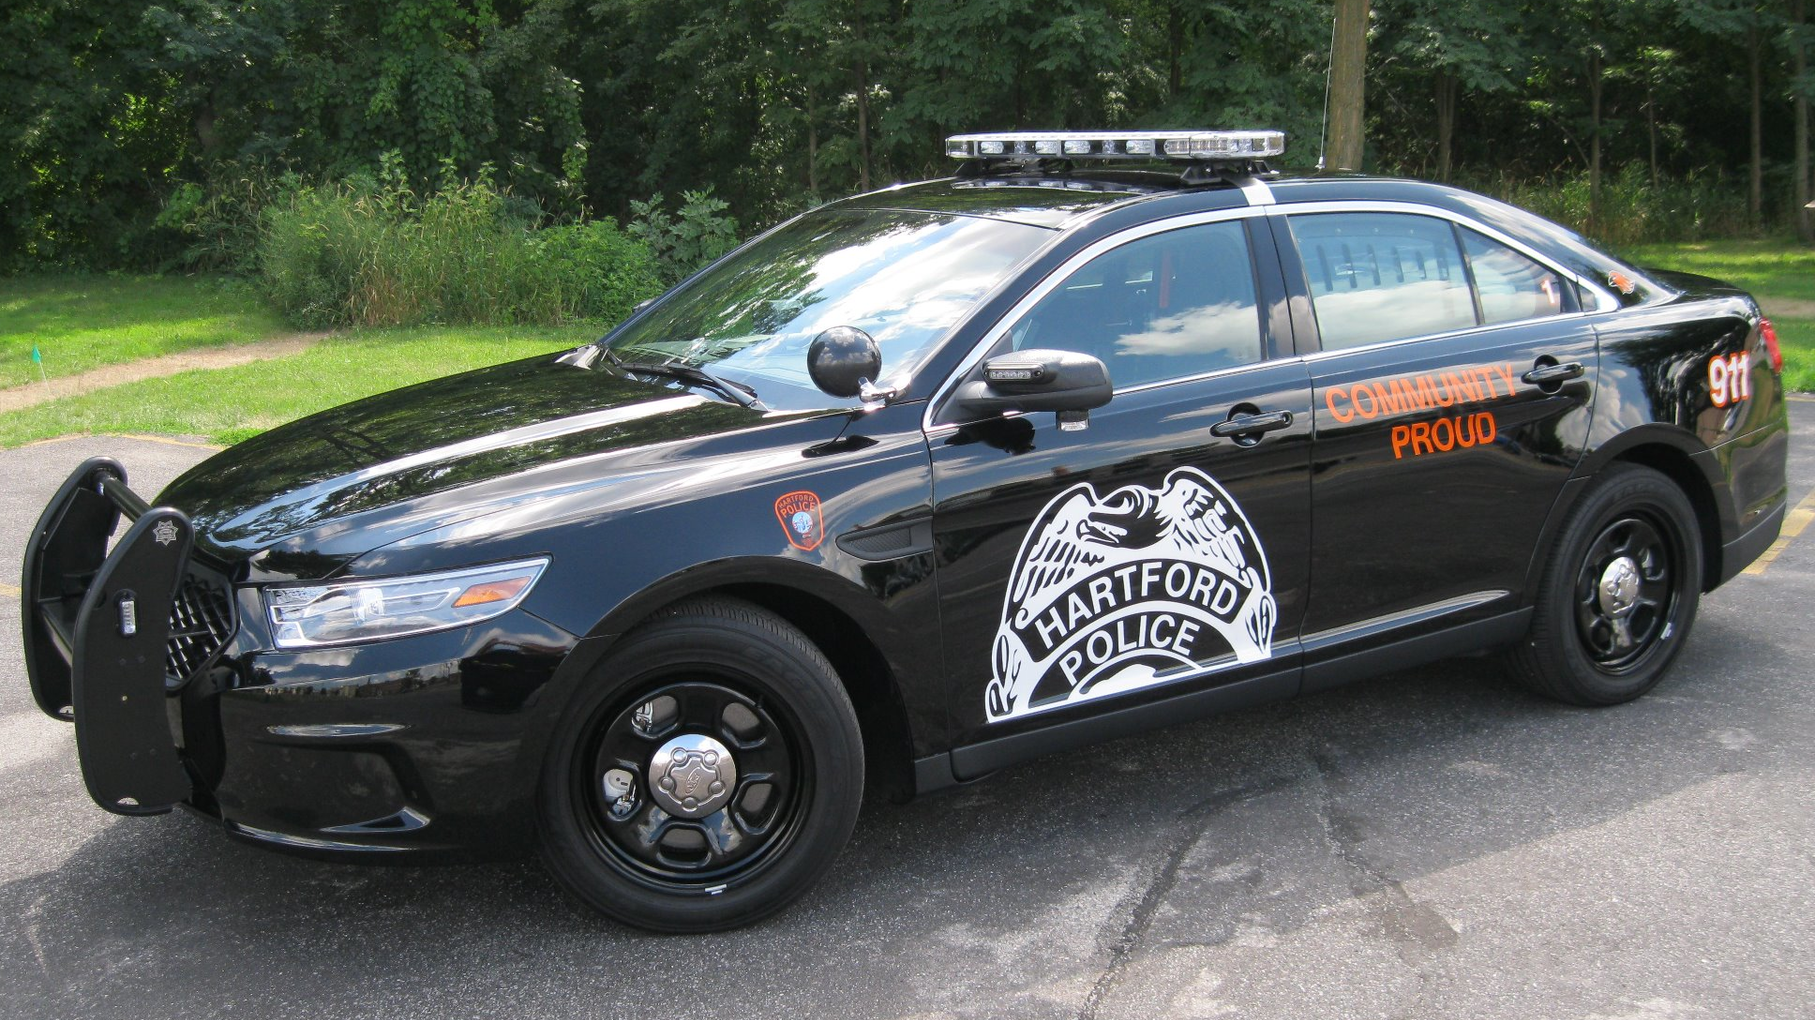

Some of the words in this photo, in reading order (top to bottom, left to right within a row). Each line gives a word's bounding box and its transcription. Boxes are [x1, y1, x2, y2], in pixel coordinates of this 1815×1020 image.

[1325, 363, 1516, 423] COMMUNITY
[1708, 351, 1751, 408] 911
[1391, 411, 1497, 459] PROUD
[778, 494, 814, 509] HARTFORD
[780, 501, 816, 518] POLICE
[1034, 562, 1238, 650] HARTFORD
[1058, 614, 1201, 687] POLICE
